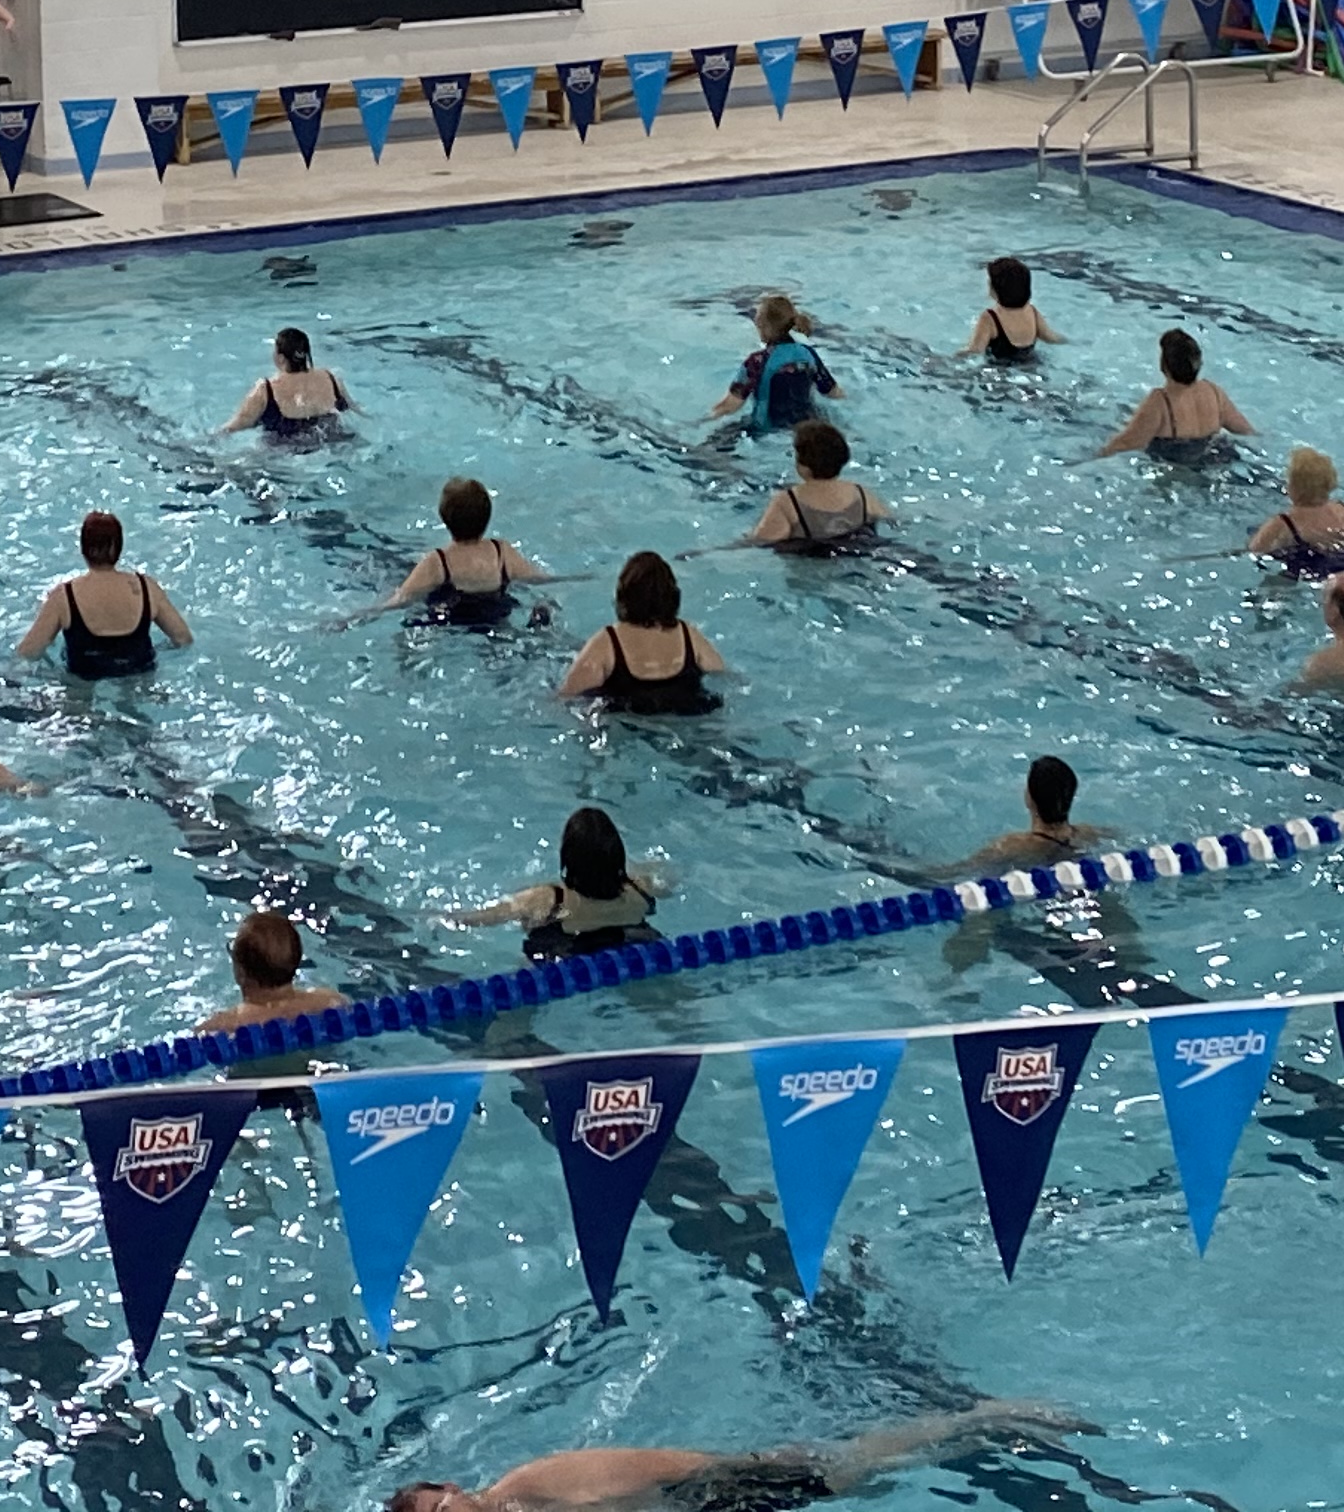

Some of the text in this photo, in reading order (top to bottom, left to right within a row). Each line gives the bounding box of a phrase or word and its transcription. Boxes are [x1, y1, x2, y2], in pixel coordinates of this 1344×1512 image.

[1175, 1029, 1266, 1065] speedo
[779, 1063, 878, 1101] speedo
[1003, 1054, 1049, 1079] USA
[346, 1096, 455, 1137] speedo
[593, 1088, 641, 1114] USA
[138, 1124, 190, 1152] USA
